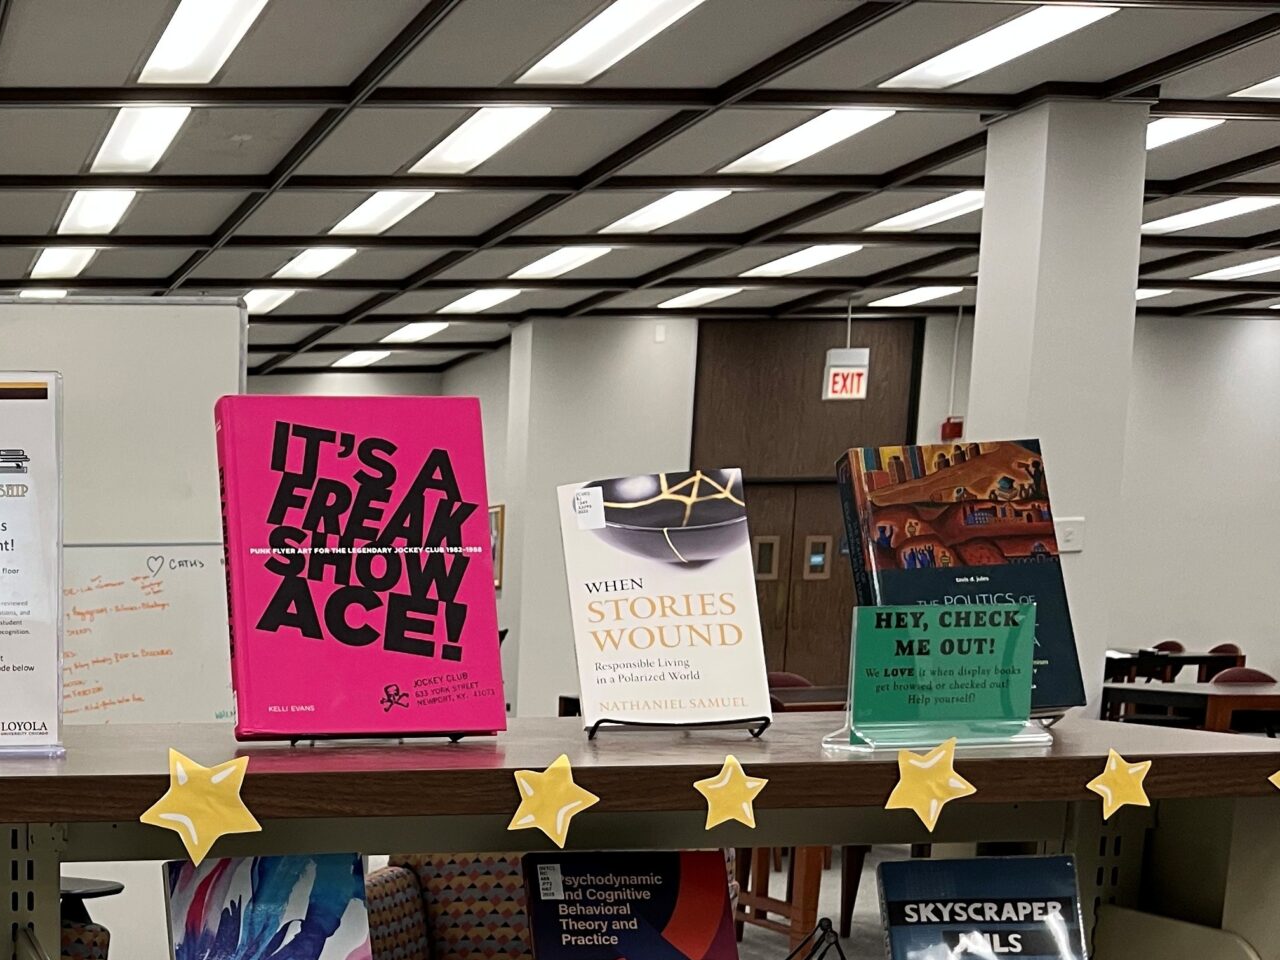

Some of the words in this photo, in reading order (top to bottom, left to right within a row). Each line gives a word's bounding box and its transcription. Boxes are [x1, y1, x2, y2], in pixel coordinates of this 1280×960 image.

[832, 373, 864, 394] EXIT
[270, 420, 398, 490] IT'S
[412, 449, 464, 502] A
[267, 471, 479, 552] FREAK
[265, 525, 470, 602] SHOW
[584, 578, 644, 594] WHEN
[587, 593, 737, 623] STORIES
[256, 575, 468, 662] ACE!
[874, 611, 930, 632] HEY,
[938, 610, 1022, 628] CHECK
[590, 623, 743, 652] WOUND
[894, 639, 931, 657] ME
[940, 638, 996, 656] OUT!
[594, 658, 656, 672] Responsible
[658, 658, 690, 670] Living
[596, 676, 607, 685] in
[618, 672, 666, 684] Polarized
[668, 671, 700, 682] World
[269, 705, 288, 713] KELLI
[291, 705, 315, 713] EVANS
[599, 699, 687, 713] NATHANIEL
[689, 697, 749, 710] SAMUEL
[1, 721, 48, 732] LOYOLA
[586, 888, 651, 902] Cognitive
[559, 903, 631, 915] Behavioral
[904, 902, 1064, 923] SKYSCRAPER
[559, 918, 608, 933] Theory
[612, 917, 638, 930] and
[562, 933, 619, 945] Practice
